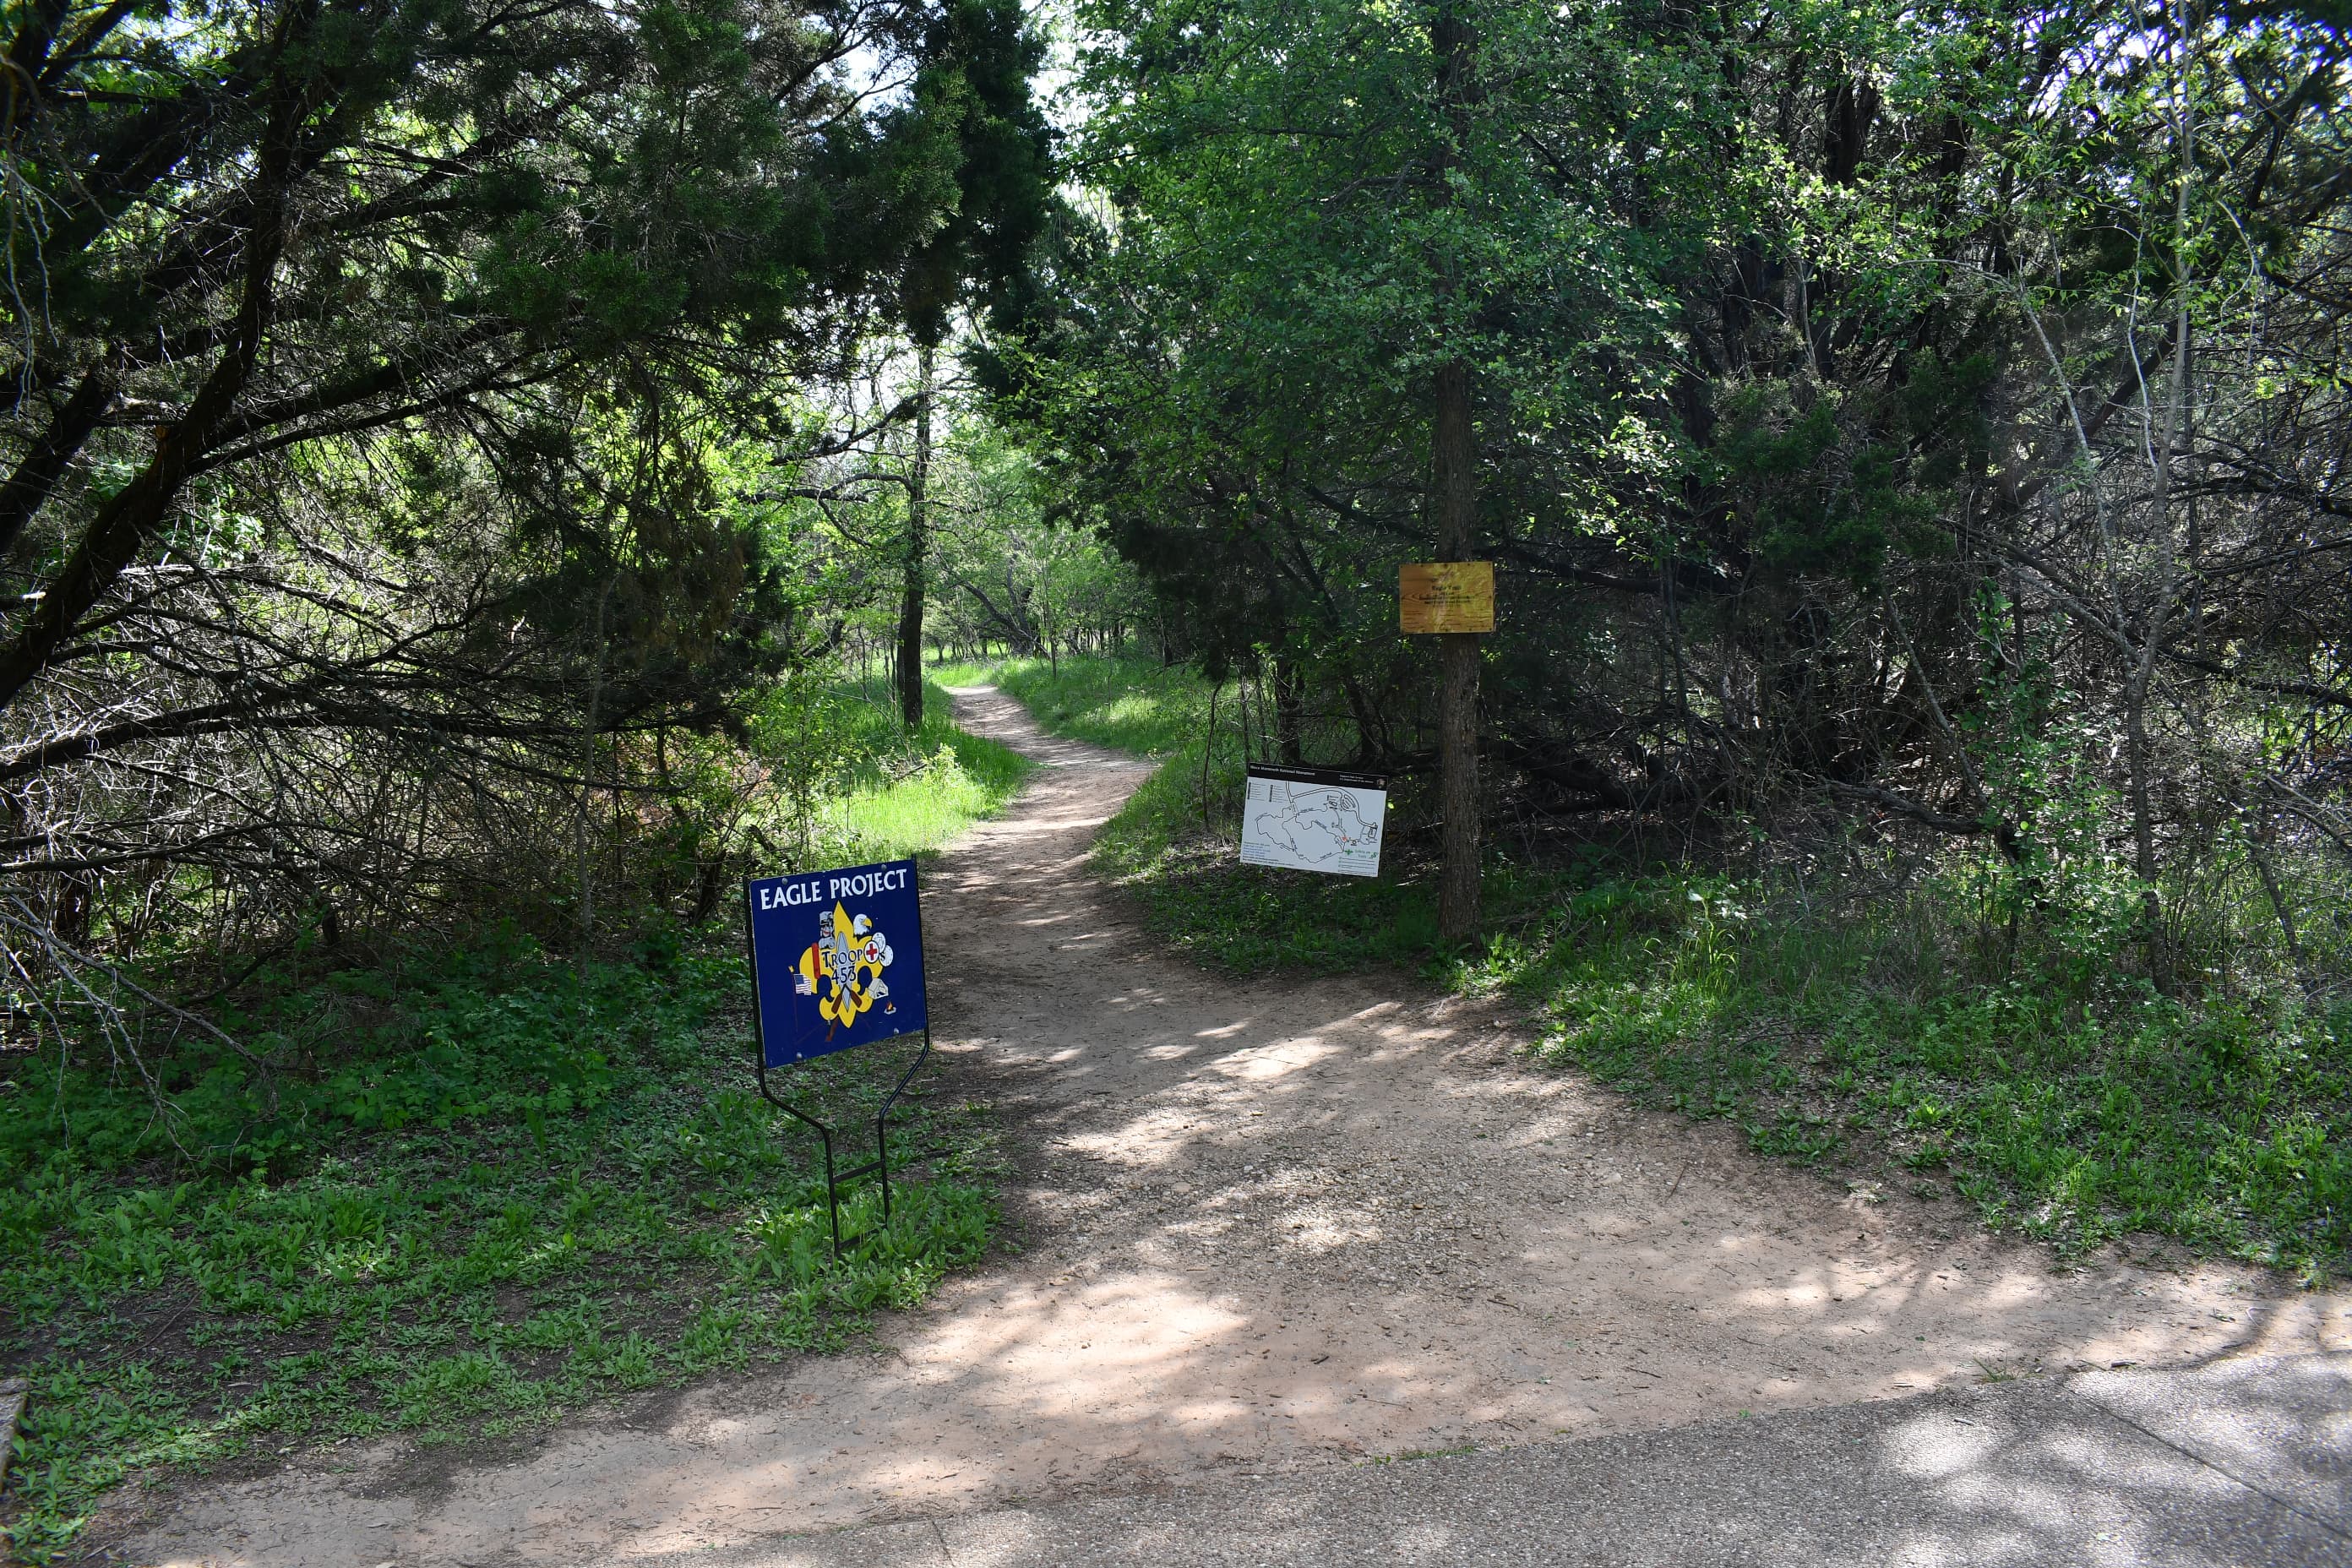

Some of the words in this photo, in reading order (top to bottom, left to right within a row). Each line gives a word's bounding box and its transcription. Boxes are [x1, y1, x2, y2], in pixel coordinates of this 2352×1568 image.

[760, 881, 823, 910] EAGLE
[830, 868, 908, 899] PROJECT
[822, 949, 863, 968] TROOP
[831, 966, 856, 984] 453
